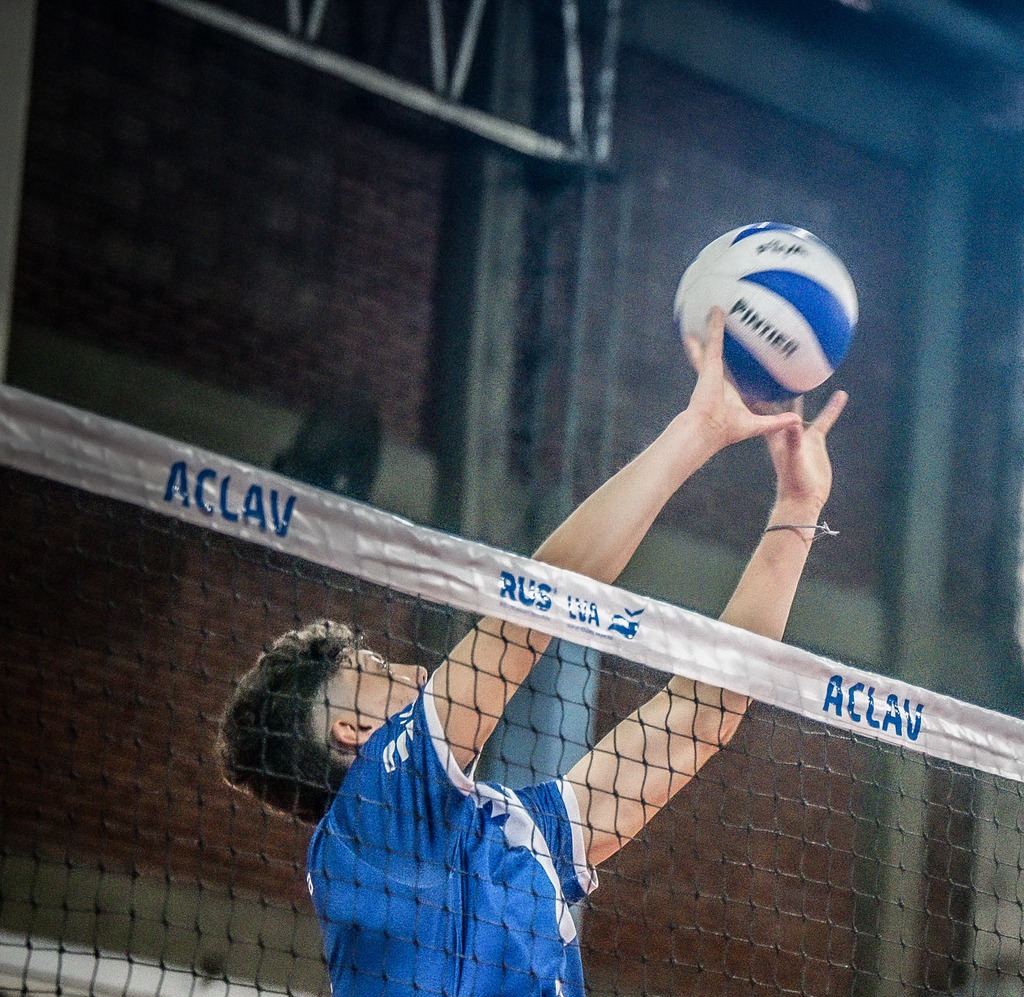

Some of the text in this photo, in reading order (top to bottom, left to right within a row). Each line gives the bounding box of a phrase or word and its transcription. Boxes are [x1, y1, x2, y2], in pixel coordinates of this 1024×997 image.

[164, 460, 297, 538] ACLAV
[500, 571, 552, 612] RUS
[567, 595, 600, 627] LVA
[823, 675, 925, 741] ACLAV
